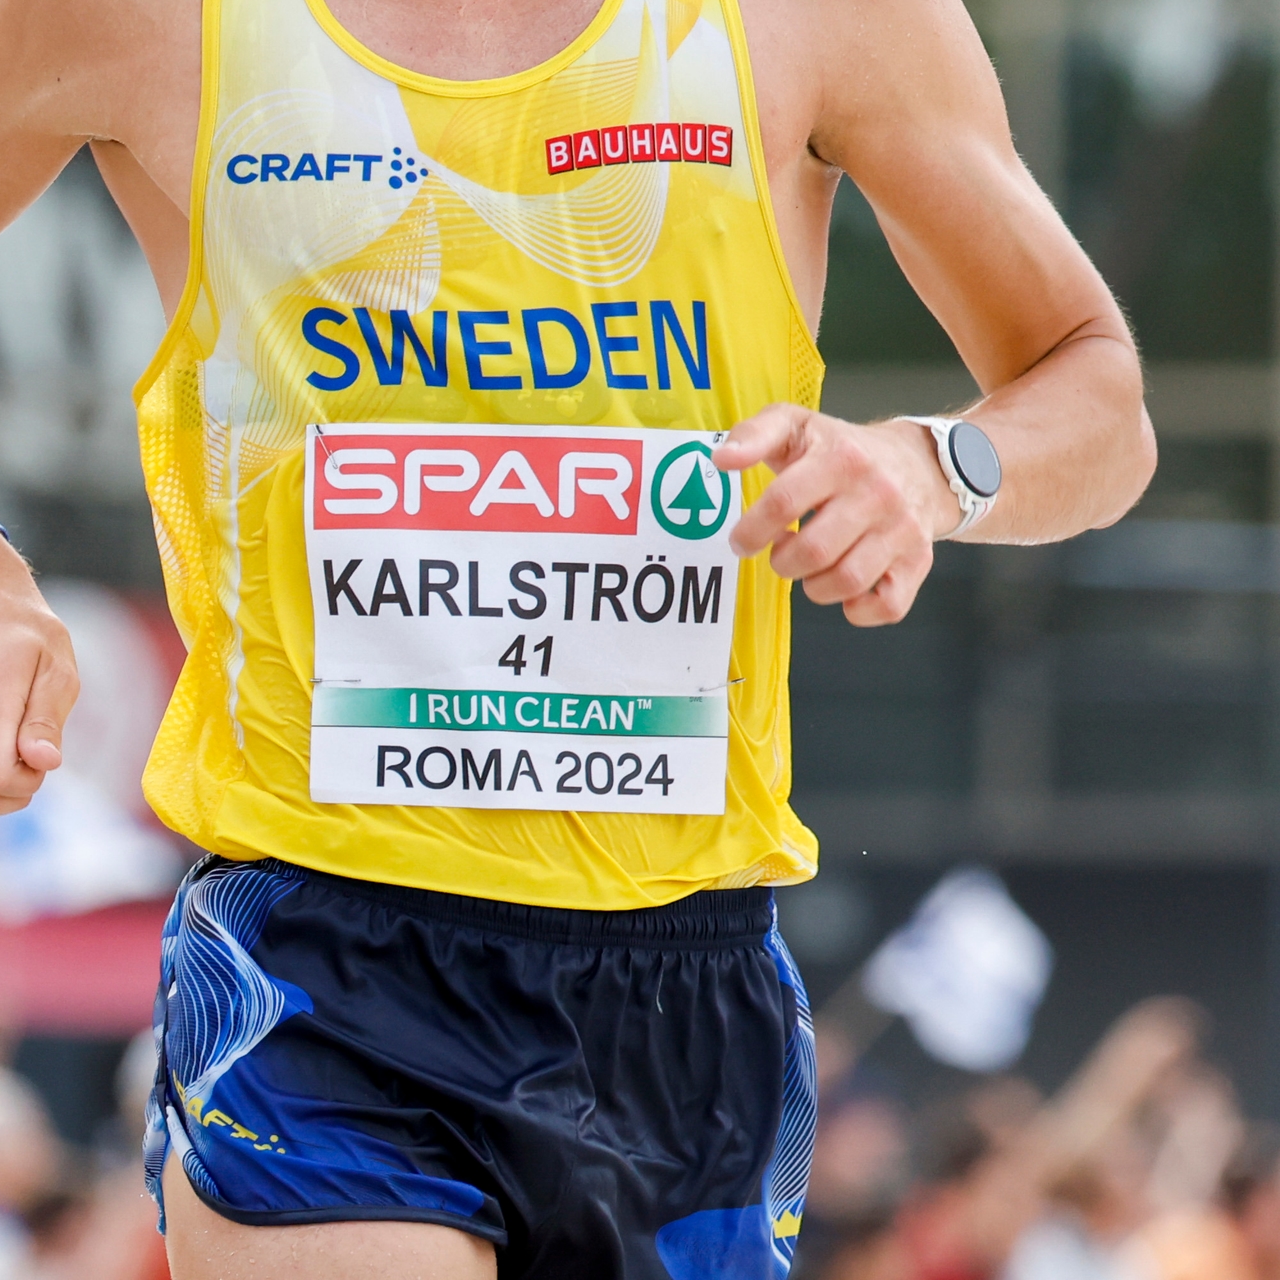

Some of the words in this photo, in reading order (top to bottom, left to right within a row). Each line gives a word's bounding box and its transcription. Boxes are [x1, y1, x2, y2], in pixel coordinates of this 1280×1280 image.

[226, 153, 383, 183] CRAFT
[549, 125, 730, 170] BAUHAUS
[300, 299, 711, 391] SWEDEN
[323, 447, 634, 521] SPAR
[322, 554, 723, 624] KARLSTRÖM
[497, 634, 554, 677] 41
[409, 694, 418, 724] I
[427, 693, 507, 727] RUN
[375, 745, 544, 793] ROMA
[554, 751, 675, 797] 2024
